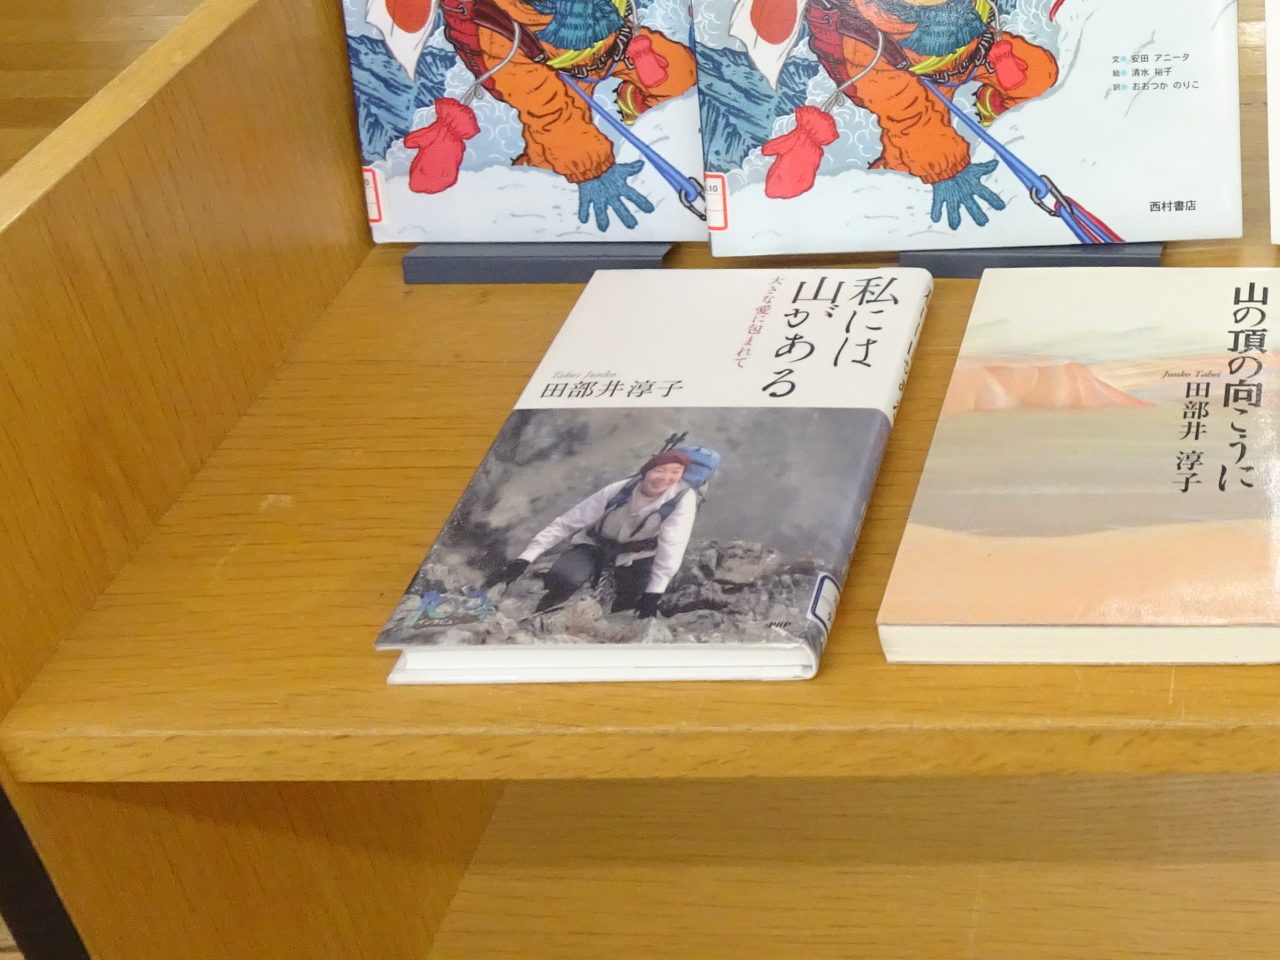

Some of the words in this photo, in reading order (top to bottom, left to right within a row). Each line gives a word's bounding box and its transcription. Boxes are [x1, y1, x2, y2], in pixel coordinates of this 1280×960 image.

[1131, 54, 1149, 64] 安田
[1154, 53, 1190, 63] アニータ
[1131, 68, 1150, 78] 清水
[1154, 67, 1173, 77] 裕子
[1132, 81, 1168, 91] おおつか
[1173, 80, 1200, 90] のりこ
[1149, 200, 1197, 213] 西村書店
[834, 276, 899, 368] 私には
[762, 276, 845, 398] 山がある
[540, 379, 684, 399] 田部井淳子
[1218, 281, 1269, 493] 山の頂の向こうに
